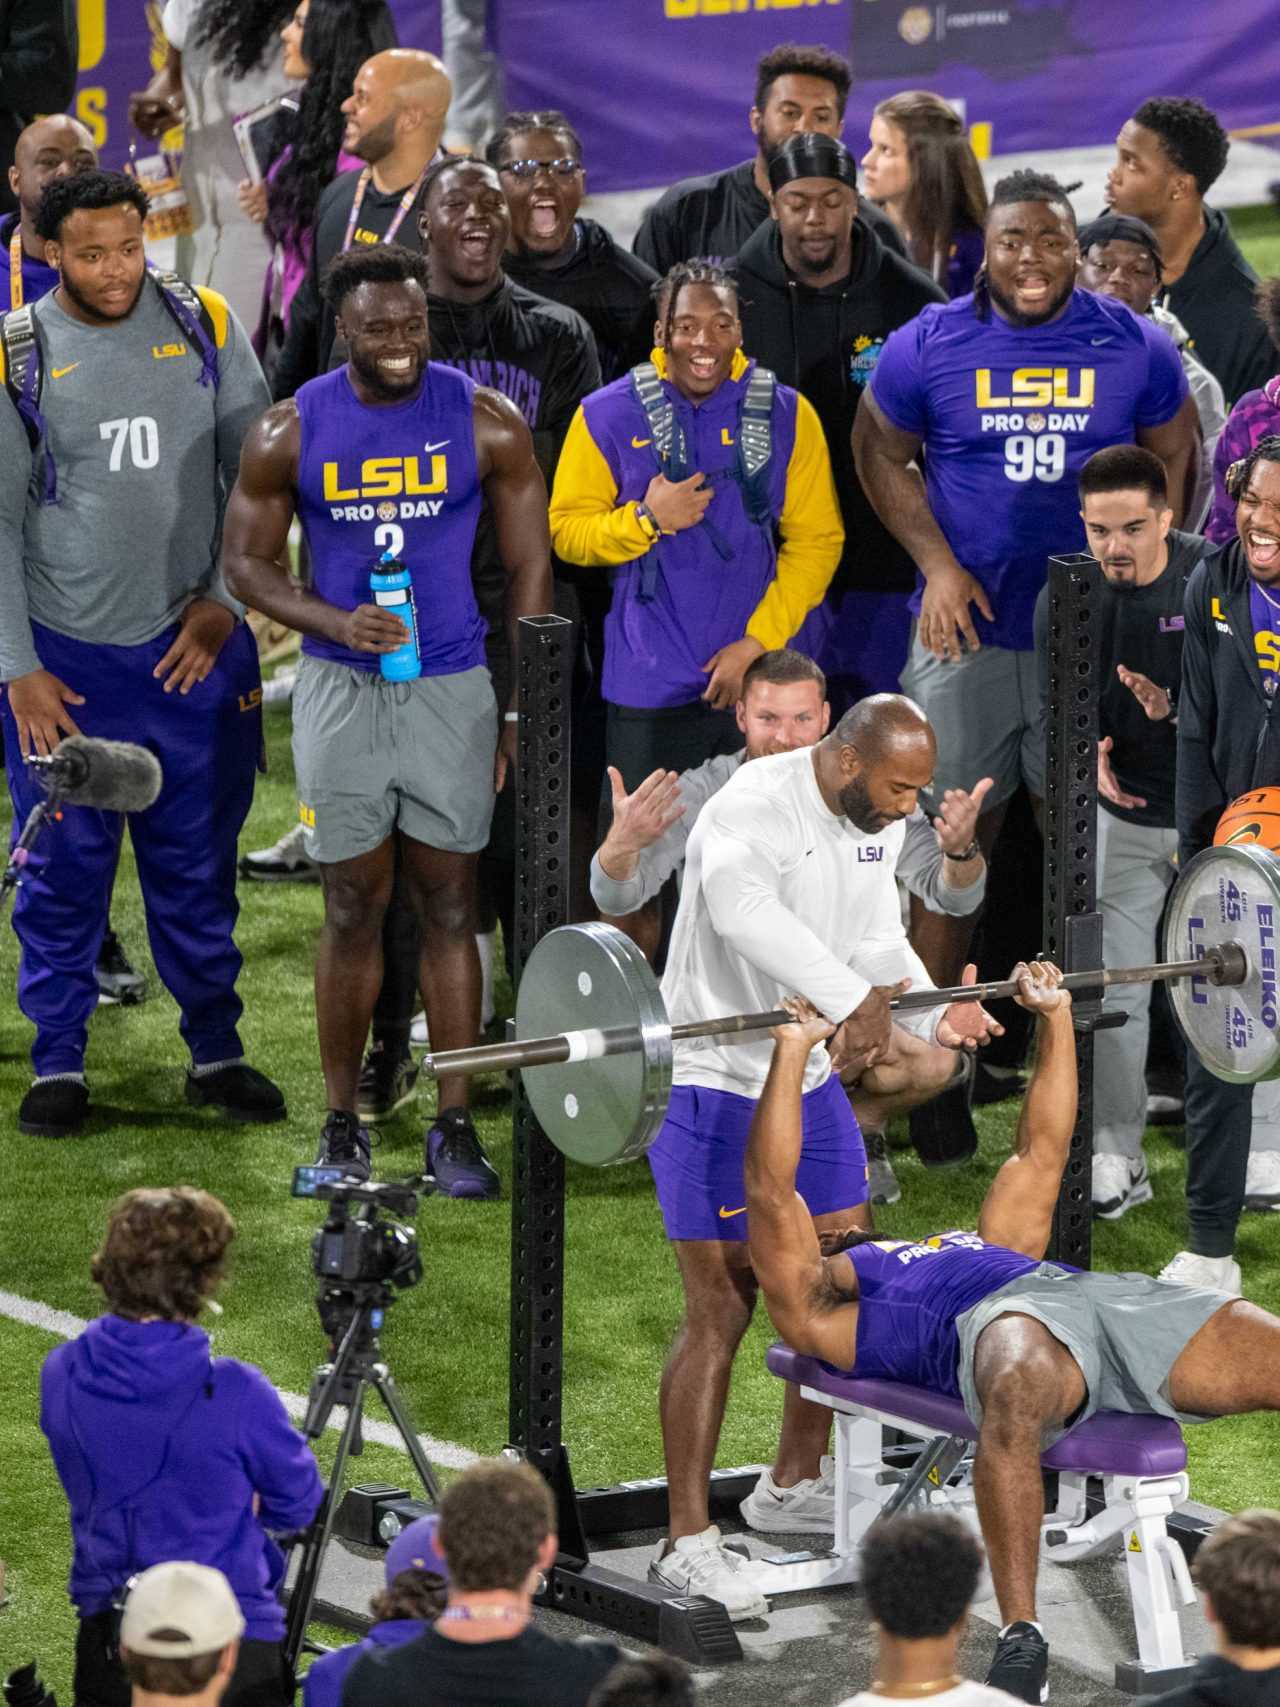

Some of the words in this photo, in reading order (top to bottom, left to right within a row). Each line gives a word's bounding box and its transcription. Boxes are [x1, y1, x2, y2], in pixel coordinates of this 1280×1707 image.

[152, 343, 187, 359] LSU
[976, 368, 1096, 409] LSU
[99, 415, 160, 472] 70
[981, 413, 1025, 432] PRO
[1047, 413, 1090, 431] DAY
[323, 454, 449, 502] LSU
[1003, 433, 1066, 483] 99
[330, 503, 375, 522] PRO
[400, 500, 444, 520] DAY
[857, 846, 884, 863] LSU
[1226, 879, 1242, 922] 45
[1256, 904, 1277, 1030] ELEIKO
[1231, 1006, 1248, 1049] 45
[896, 1244, 941, 1265] PRO
